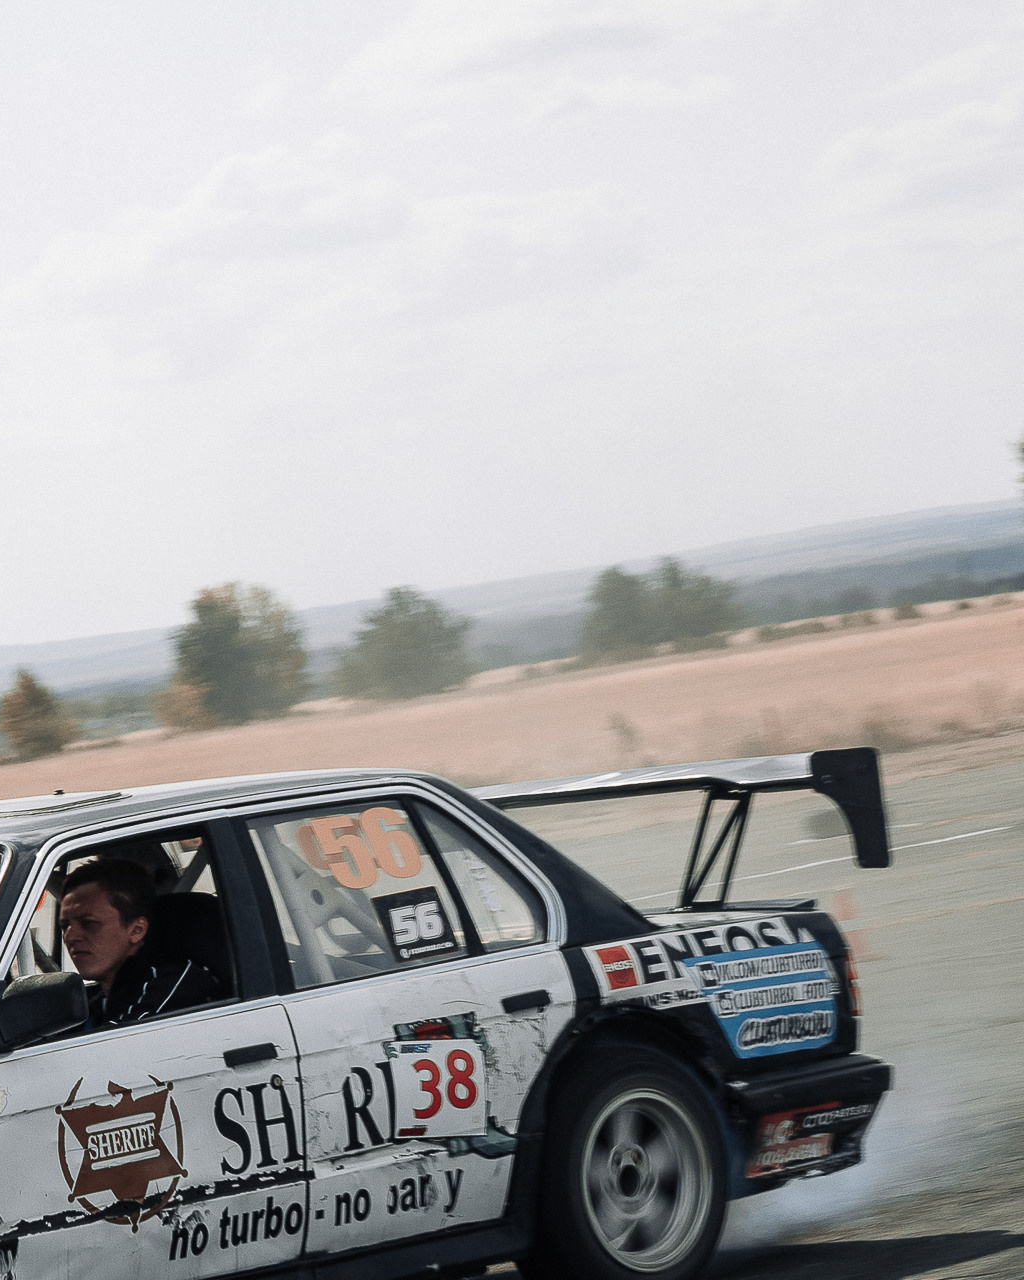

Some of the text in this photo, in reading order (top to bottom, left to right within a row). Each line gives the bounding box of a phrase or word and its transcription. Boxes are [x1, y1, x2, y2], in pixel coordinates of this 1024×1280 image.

[310, 807, 423, 890] 56
[388, 901, 444, 946] 56
[411, 1049, 478, 1119] 38
[87, 1123, 156, 1160] SHERIFF
[169, 1222, 209, 1261] no
[219, 1196, 304, 1250] turbo
[334, 1188, 370, 1227] no
